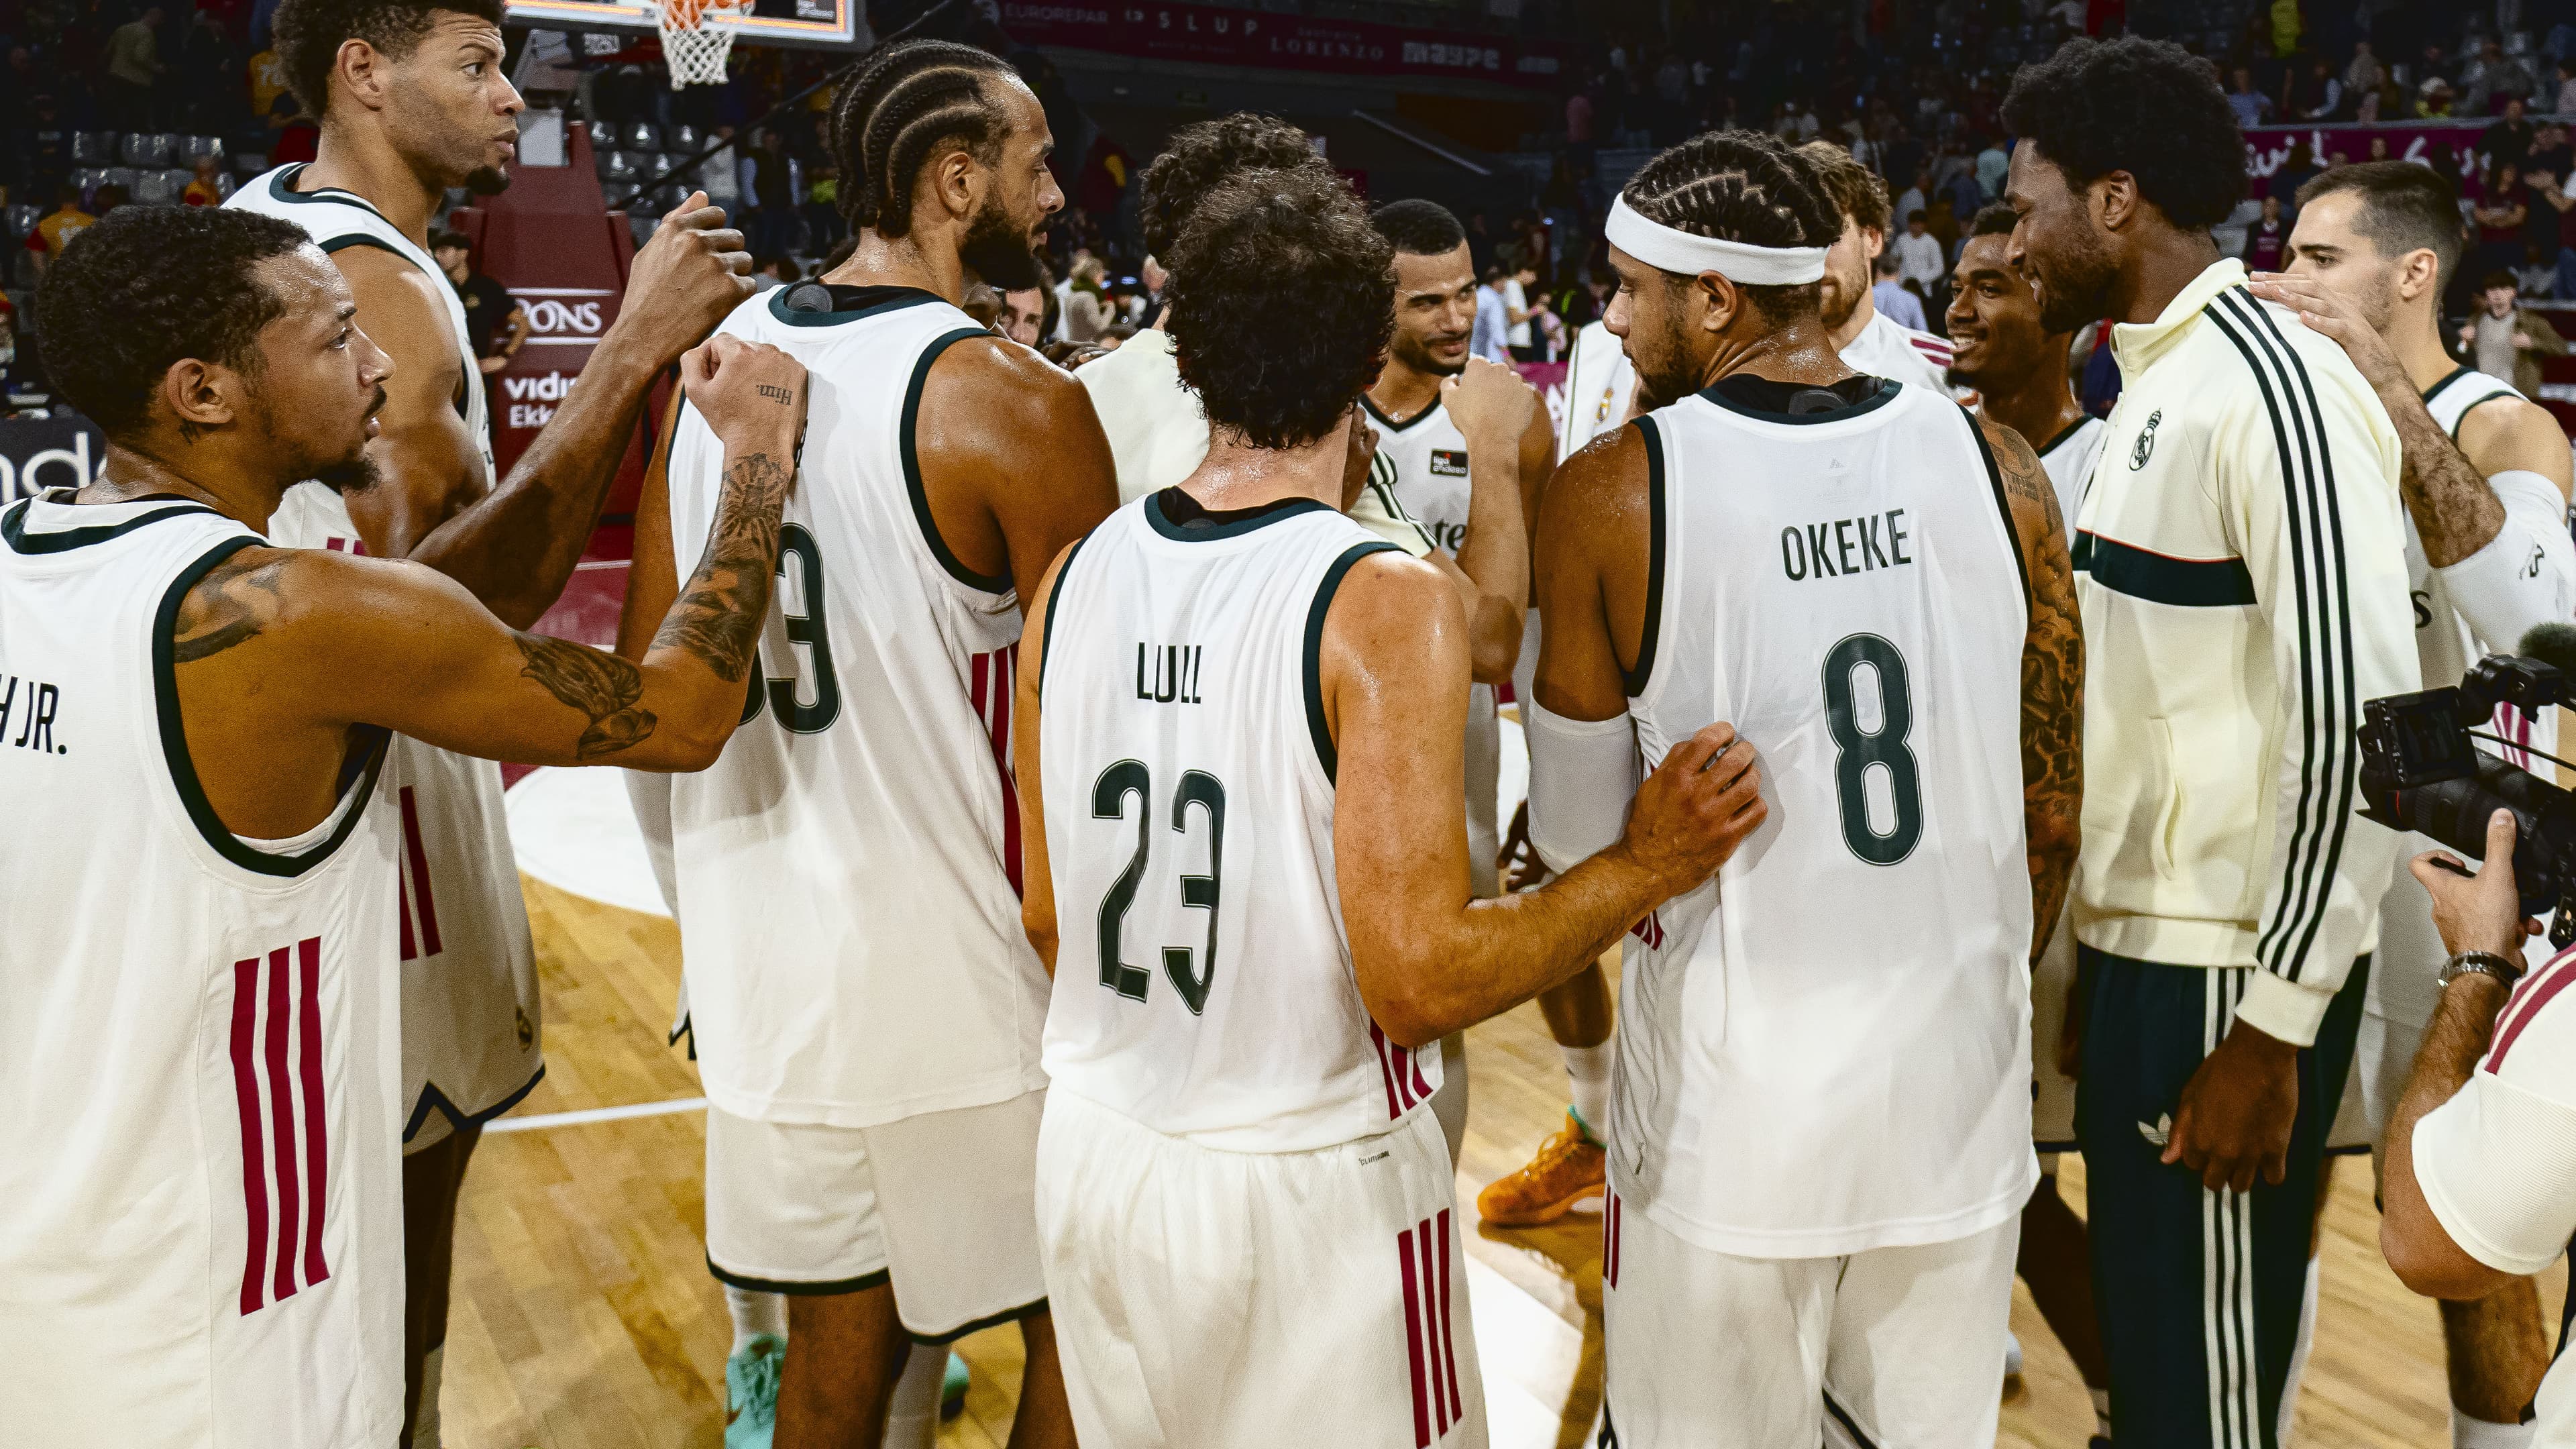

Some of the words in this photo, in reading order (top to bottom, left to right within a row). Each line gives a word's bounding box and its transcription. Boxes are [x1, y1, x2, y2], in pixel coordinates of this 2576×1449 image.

[1004, 3, 1109, 23] EUROREPAR
[1270, 36, 1385, 62] LORENZO
[1781, 508, 1912, 581] OKEKE
[739, 522, 842, 735] 3
[1137, 642, 1201, 704] LULL
[15, 681, 67, 755] JR.
[1821, 632, 1924, 867] 8
[1091, 757, 1226, 1016] 23
